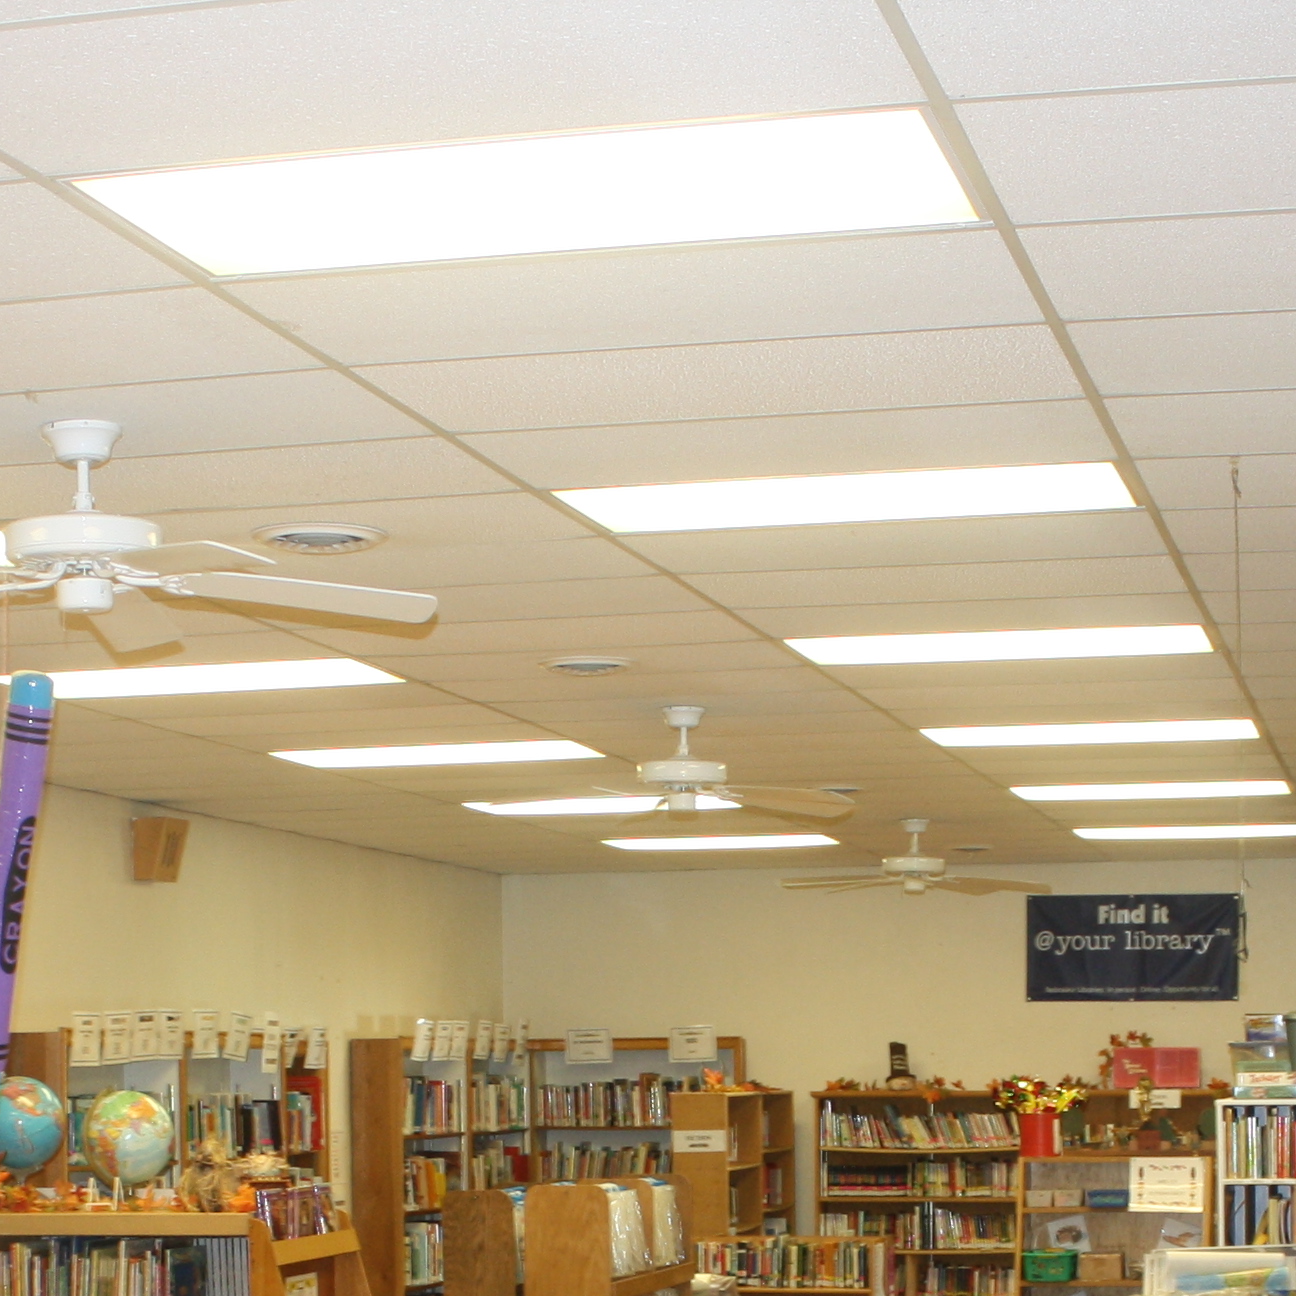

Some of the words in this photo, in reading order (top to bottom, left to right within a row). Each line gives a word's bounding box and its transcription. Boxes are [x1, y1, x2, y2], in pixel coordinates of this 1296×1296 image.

[4, 826, 36, 965] CRAYON
[1097, 903, 1146, 925] Find
[1152, 904, 1170, 924] it
[1035, 930, 1116, 956] @your
